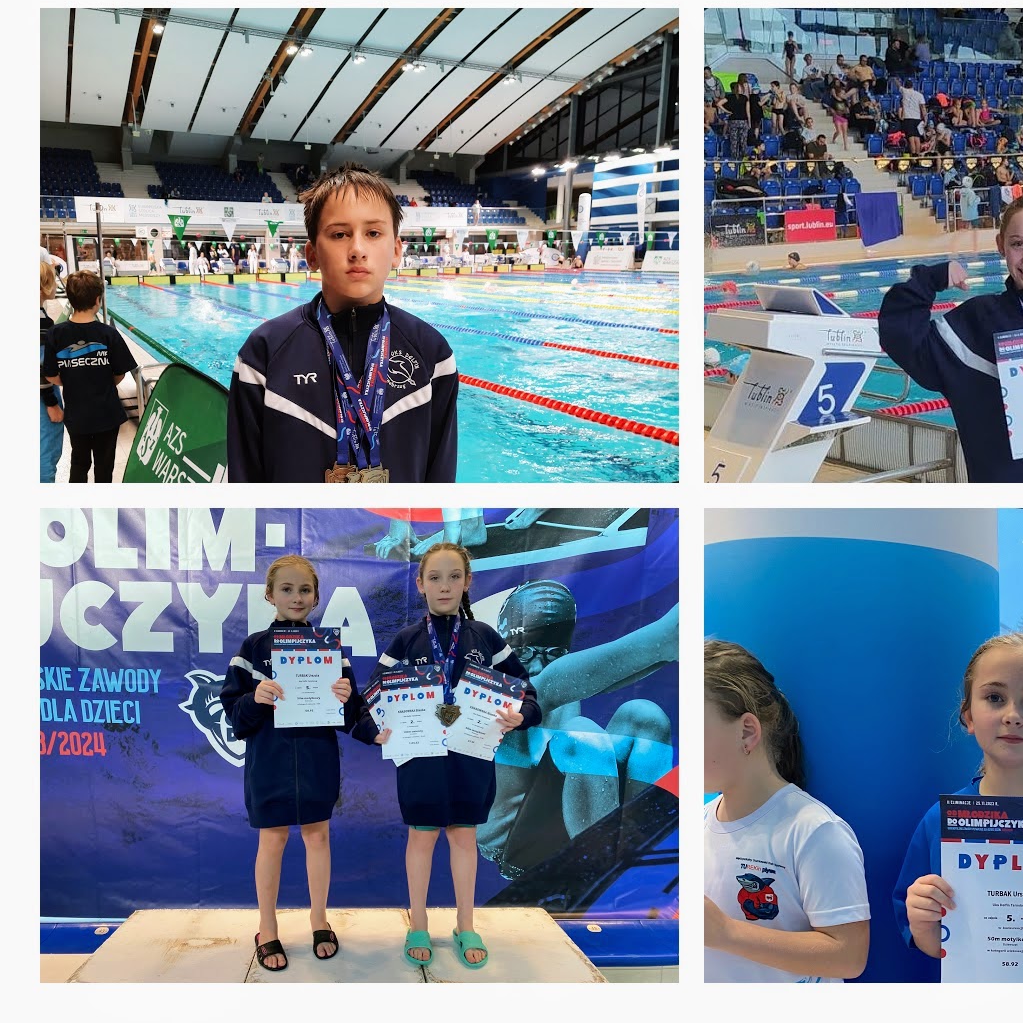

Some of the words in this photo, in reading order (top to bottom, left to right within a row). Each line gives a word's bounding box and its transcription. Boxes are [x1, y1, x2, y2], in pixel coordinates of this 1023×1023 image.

[787, 221, 834, 231] sport.lublin.eu
[293, 372, 318, 385] TYR
[817, 383, 836, 415] 5
[162, 422, 187, 456] AZS
[151, 448, 196, 483] WARS
[711, 462, 726, 483] 5
[510, 627, 526, 636] TYR
[263, 659, 272, 667] TY
[280, 656, 333, 665] DYPLOM
[415, 656, 428, 665] TYR
[78, 667, 162, 695] ZAWODY
[387, 691, 435, 703] DYPLOM
[463, 687, 513, 709] DYPLOM
[40, 697, 78, 723] DLA
[81, 698, 142, 725] DZIECI
[957, 809, 1009, 819] MŁODZIKA
[946, 817, 958, 827] DO
[1006, 914, 1016, 922] 5.
